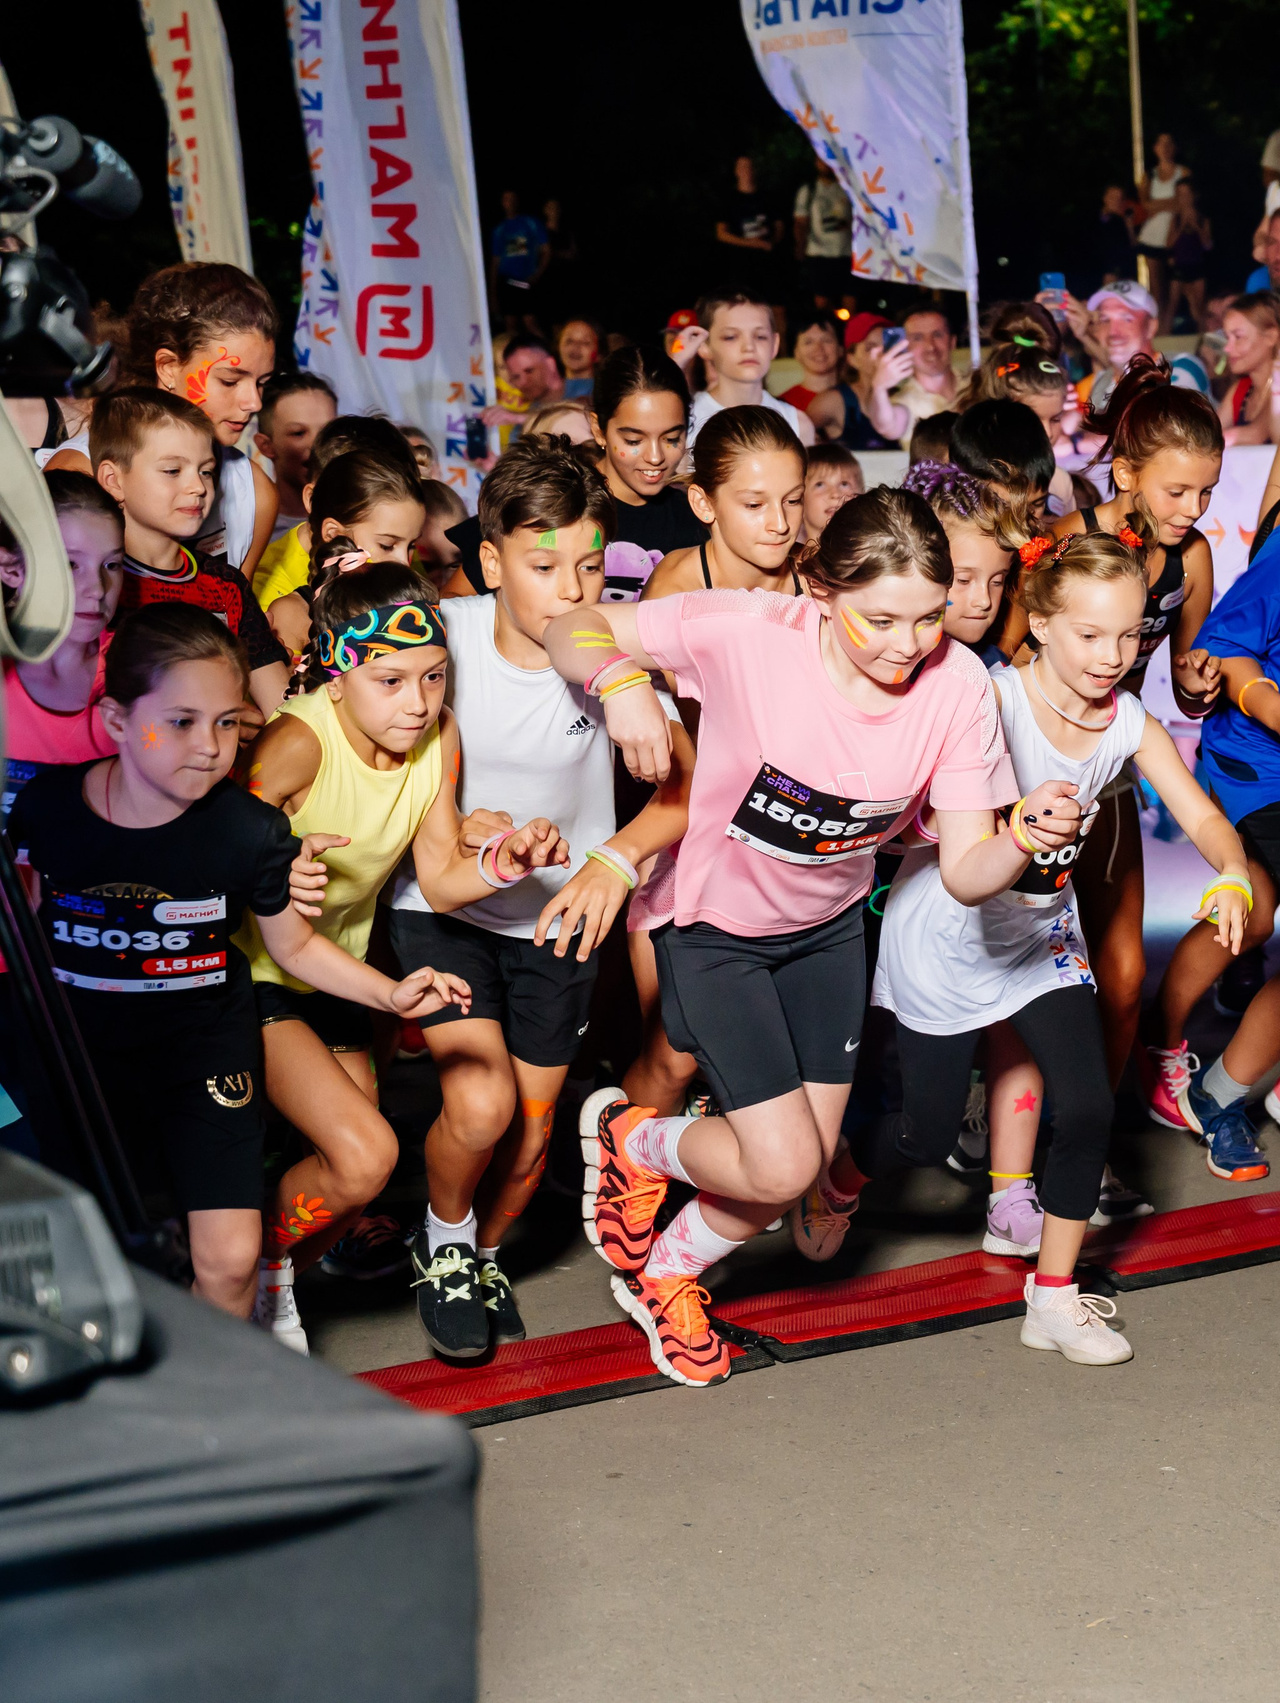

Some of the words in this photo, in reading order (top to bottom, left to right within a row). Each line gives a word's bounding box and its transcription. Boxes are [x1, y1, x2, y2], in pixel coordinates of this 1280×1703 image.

[776, 775, 794, 788] НЕ
[767, 778, 811, 803] СПАТЬ!
[749, 791, 868, 836] 15059
[827, 840, 855, 852] 1,5
[180, 909, 219, 919] МАГНИТ
[53, 920, 191, 951] 15036
[156, 959, 188, 973] 1,5
